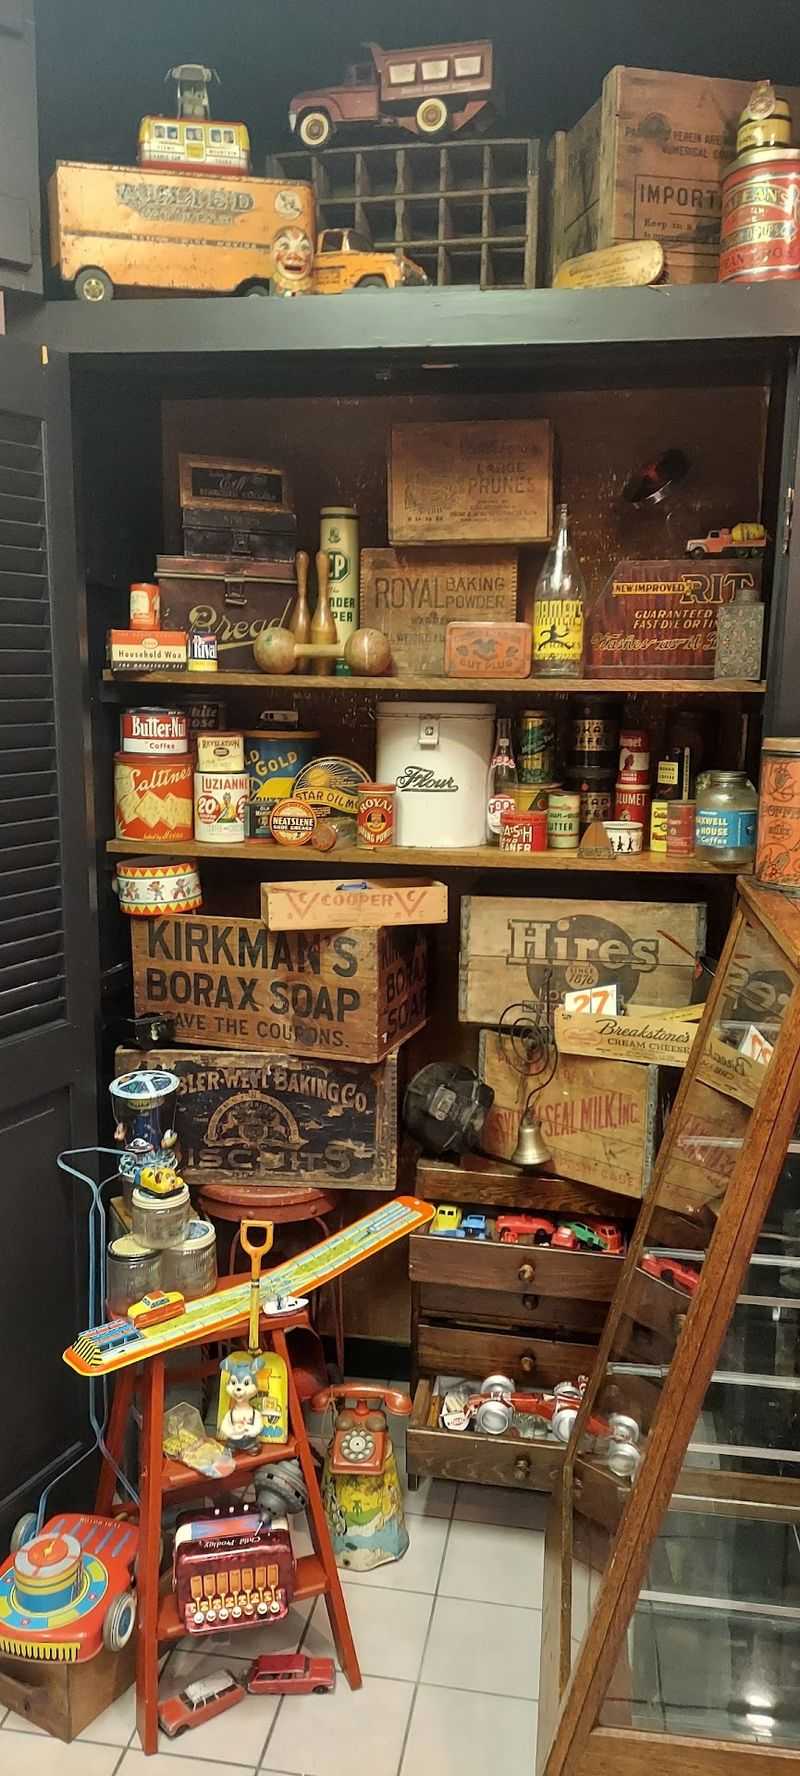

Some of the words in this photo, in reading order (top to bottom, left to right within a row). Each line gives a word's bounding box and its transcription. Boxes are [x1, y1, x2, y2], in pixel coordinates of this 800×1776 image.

[640, 184, 720, 209] IMPORT
[376, 577, 443, 609] ROYAL
[447, 575, 505, 592] BAKING
[681, 573, 754, 604] RIT
[446, 594, 505, 609] POWDER
[635, 610, 713, 619] GUARANTEED
[118, 651, 162, 659] Household
[255, 751, 298, 777] GOLD
[130, 766, 194, 793] Saltines
[396, 765, 459, 793] Flour
[201, 798, 216, 815] 20
[295, 791, 324, 801] STAR
[359, 798, 394, 813] ROYAL
[616, 792, 646, 807] LUMET
[701, 827, 728, 836] HOUSE
[321, 892, 394, 908] COOPER
[148, 920, 359, 978] KIRKMAN'S
[507, 916, 660, 973] Hires
[146, 967, 261, 1012] BORAX
[270, 980, 362, 1022] SOAP
[574, 990, 610, 1015] 27
[214, 1016, 249, 1035] THE
[595, 1018, 690, 1043] Breakstone's
[607, 1038, 646, 1049] CREAM
[273, 1067, 340, 1104] BAKING
[544, 1101, 578, 1137] SEAL
